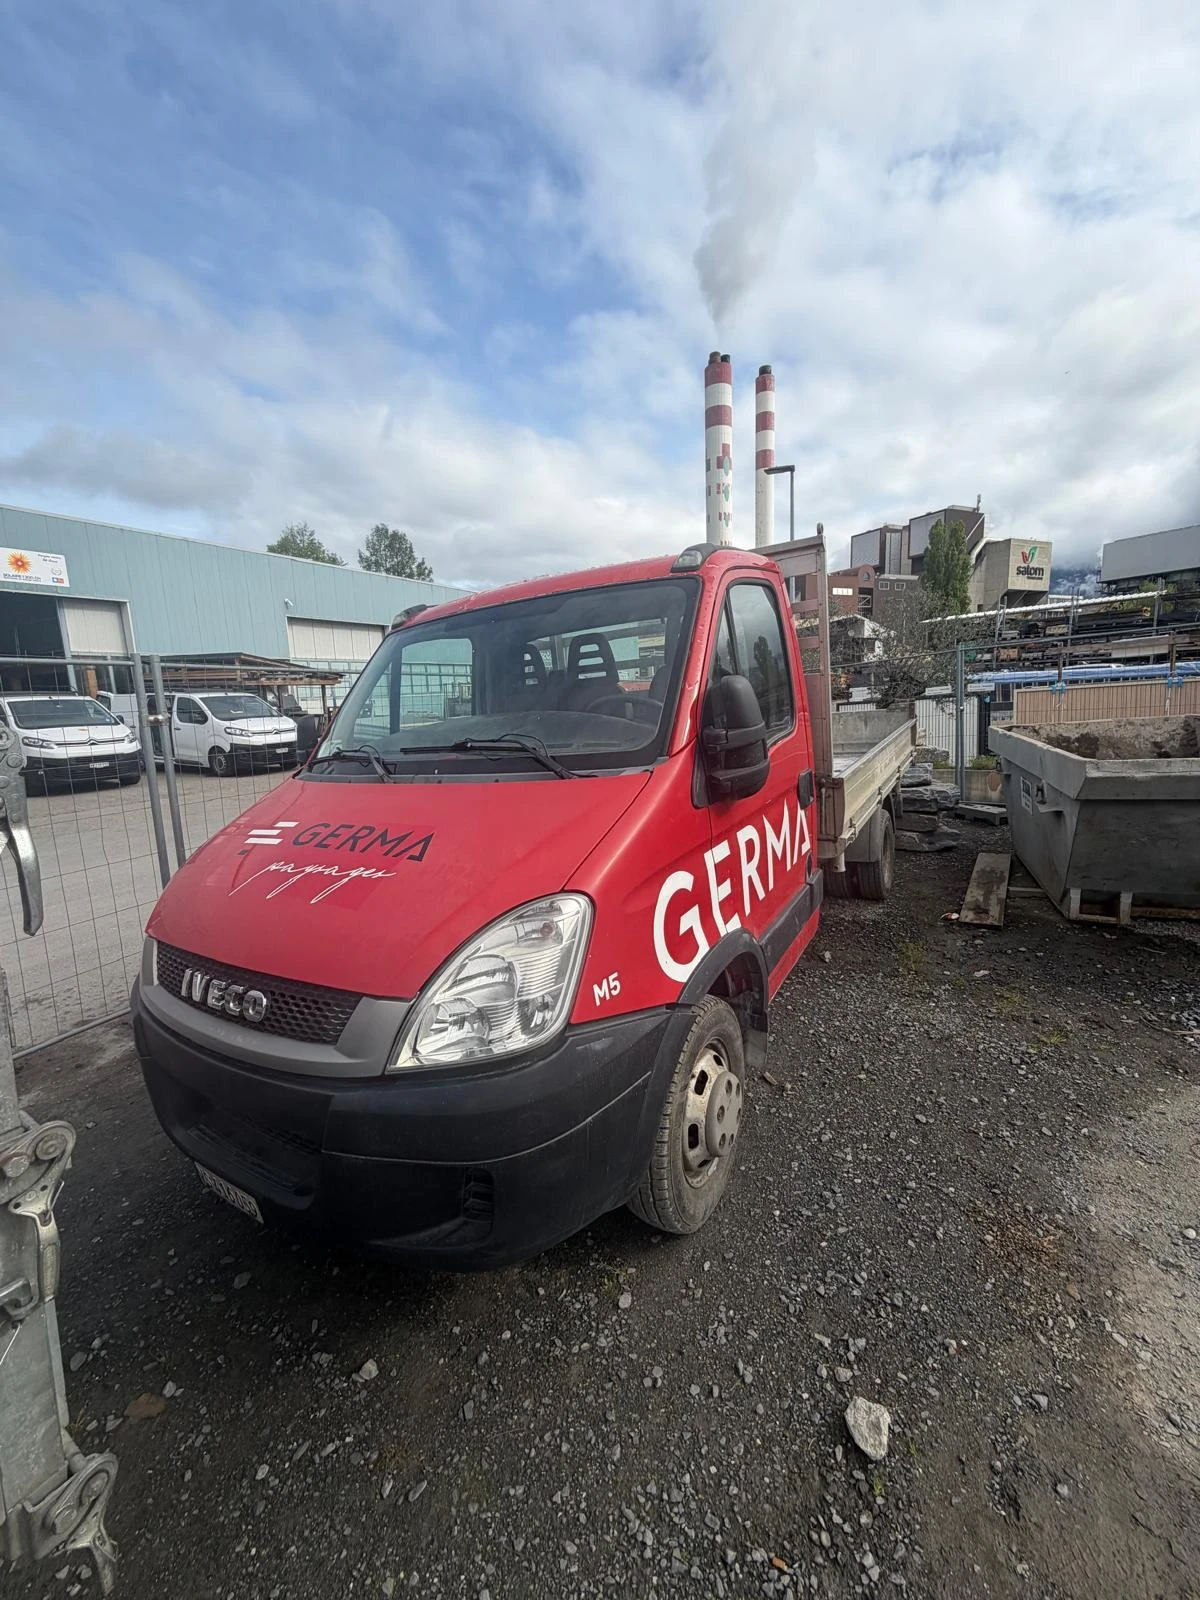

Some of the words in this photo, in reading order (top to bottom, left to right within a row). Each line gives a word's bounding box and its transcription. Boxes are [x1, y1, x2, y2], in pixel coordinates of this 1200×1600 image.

[291, 822, 435, 862] GERMA
[653, 798, 811, 983] GERMA
[181, 967, 267, 1023] IVECO
[592, 972, 621, 1007] M5
